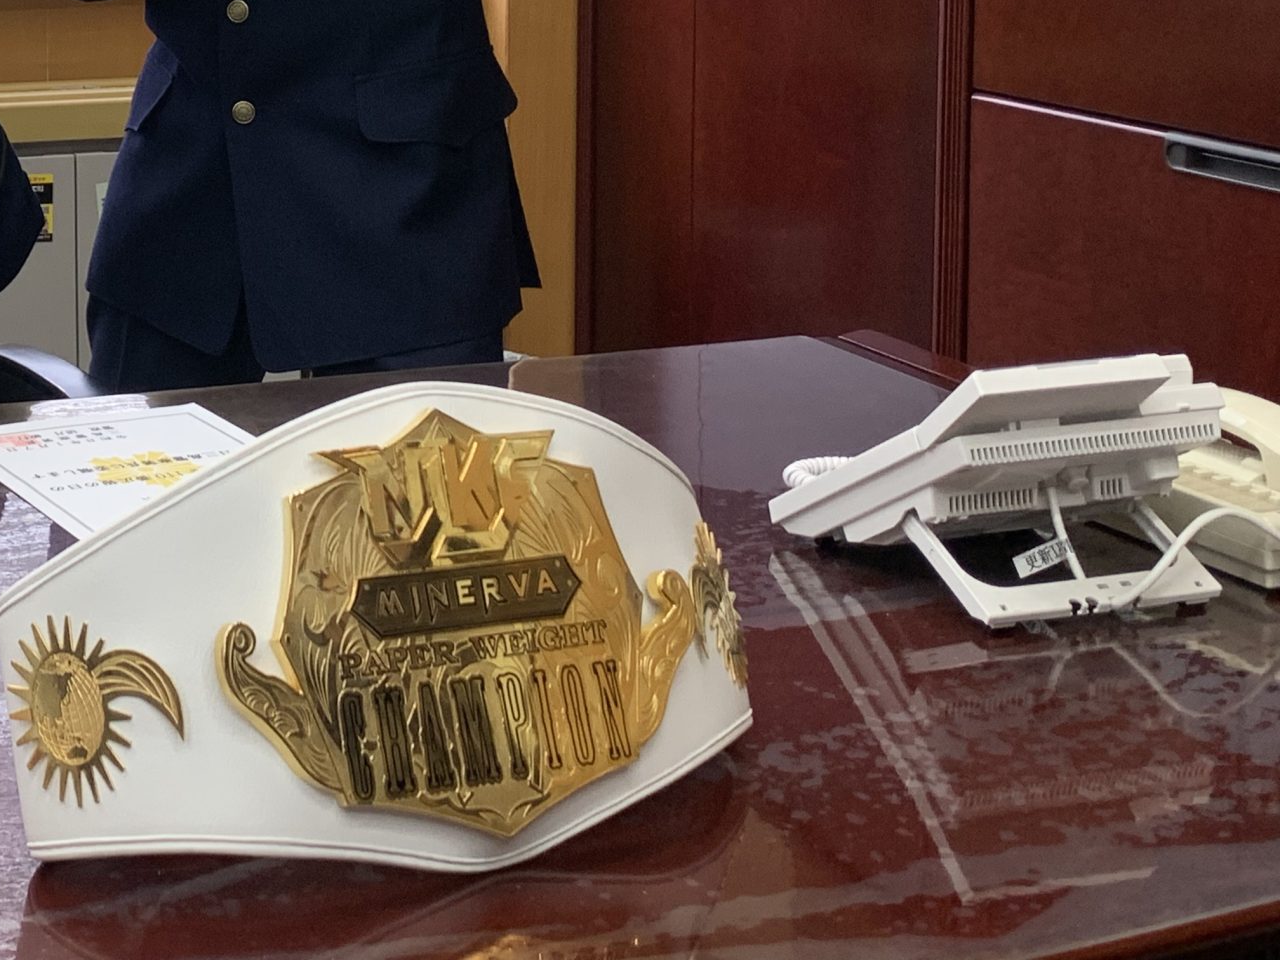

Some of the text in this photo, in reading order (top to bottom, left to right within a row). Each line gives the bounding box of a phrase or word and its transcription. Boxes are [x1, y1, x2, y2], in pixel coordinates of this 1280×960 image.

[374, 568, 558, 624] MINERVA
[338, 619, 607, 681] PAPER WEIGHT
[338, 658, 632, 804] CHAMPION
